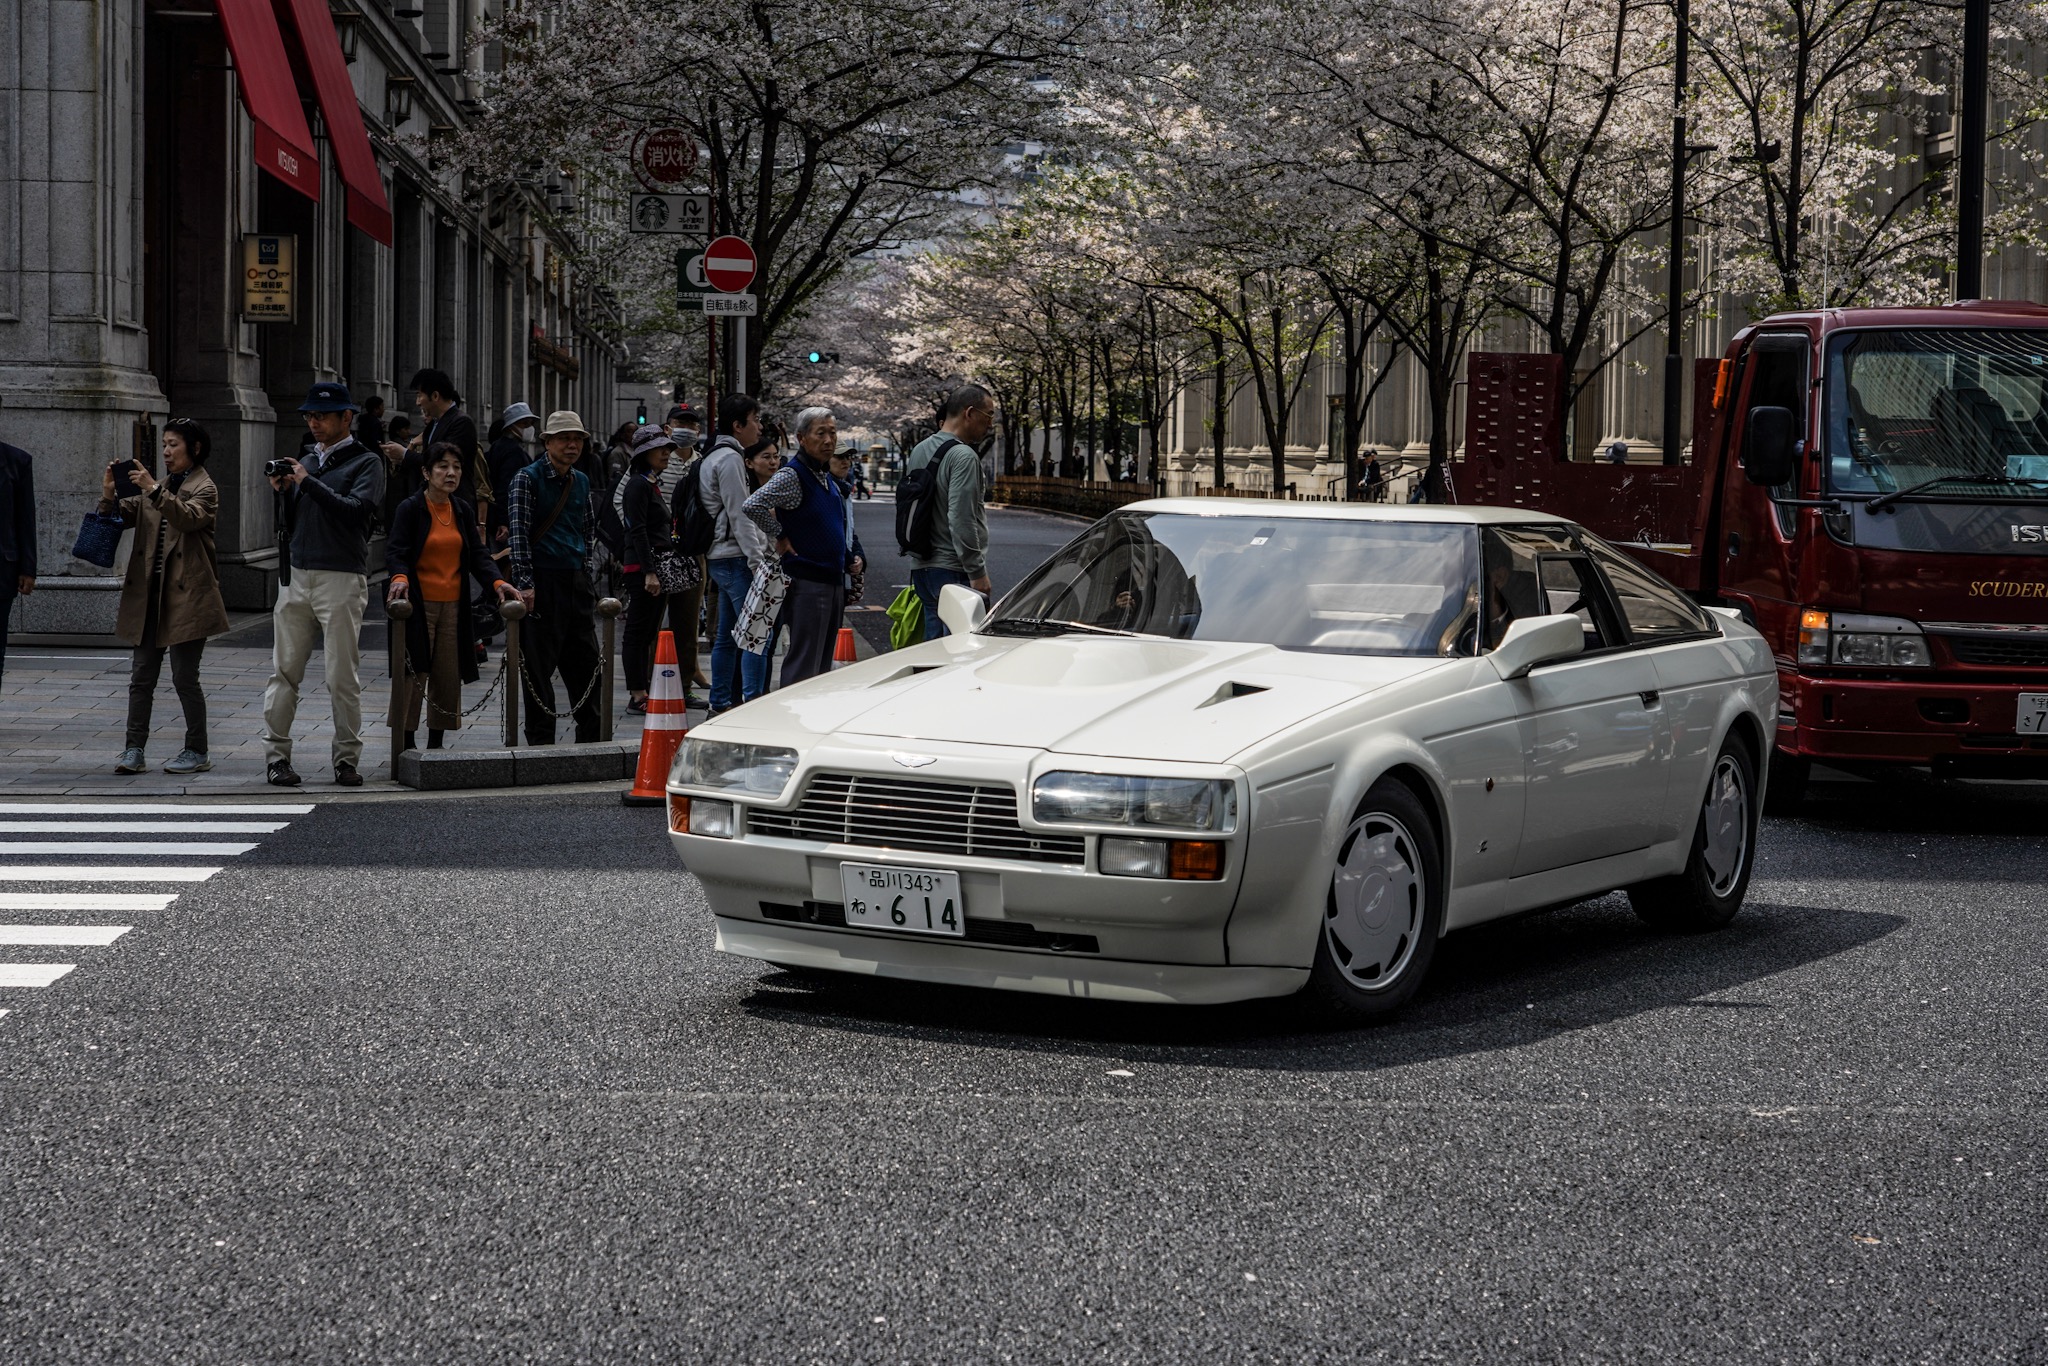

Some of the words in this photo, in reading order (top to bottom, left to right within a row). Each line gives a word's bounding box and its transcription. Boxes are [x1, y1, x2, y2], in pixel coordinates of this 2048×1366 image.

[706, 299, 754, 312] 自転車を除く
[2010, 524, 2048, 543] IS
